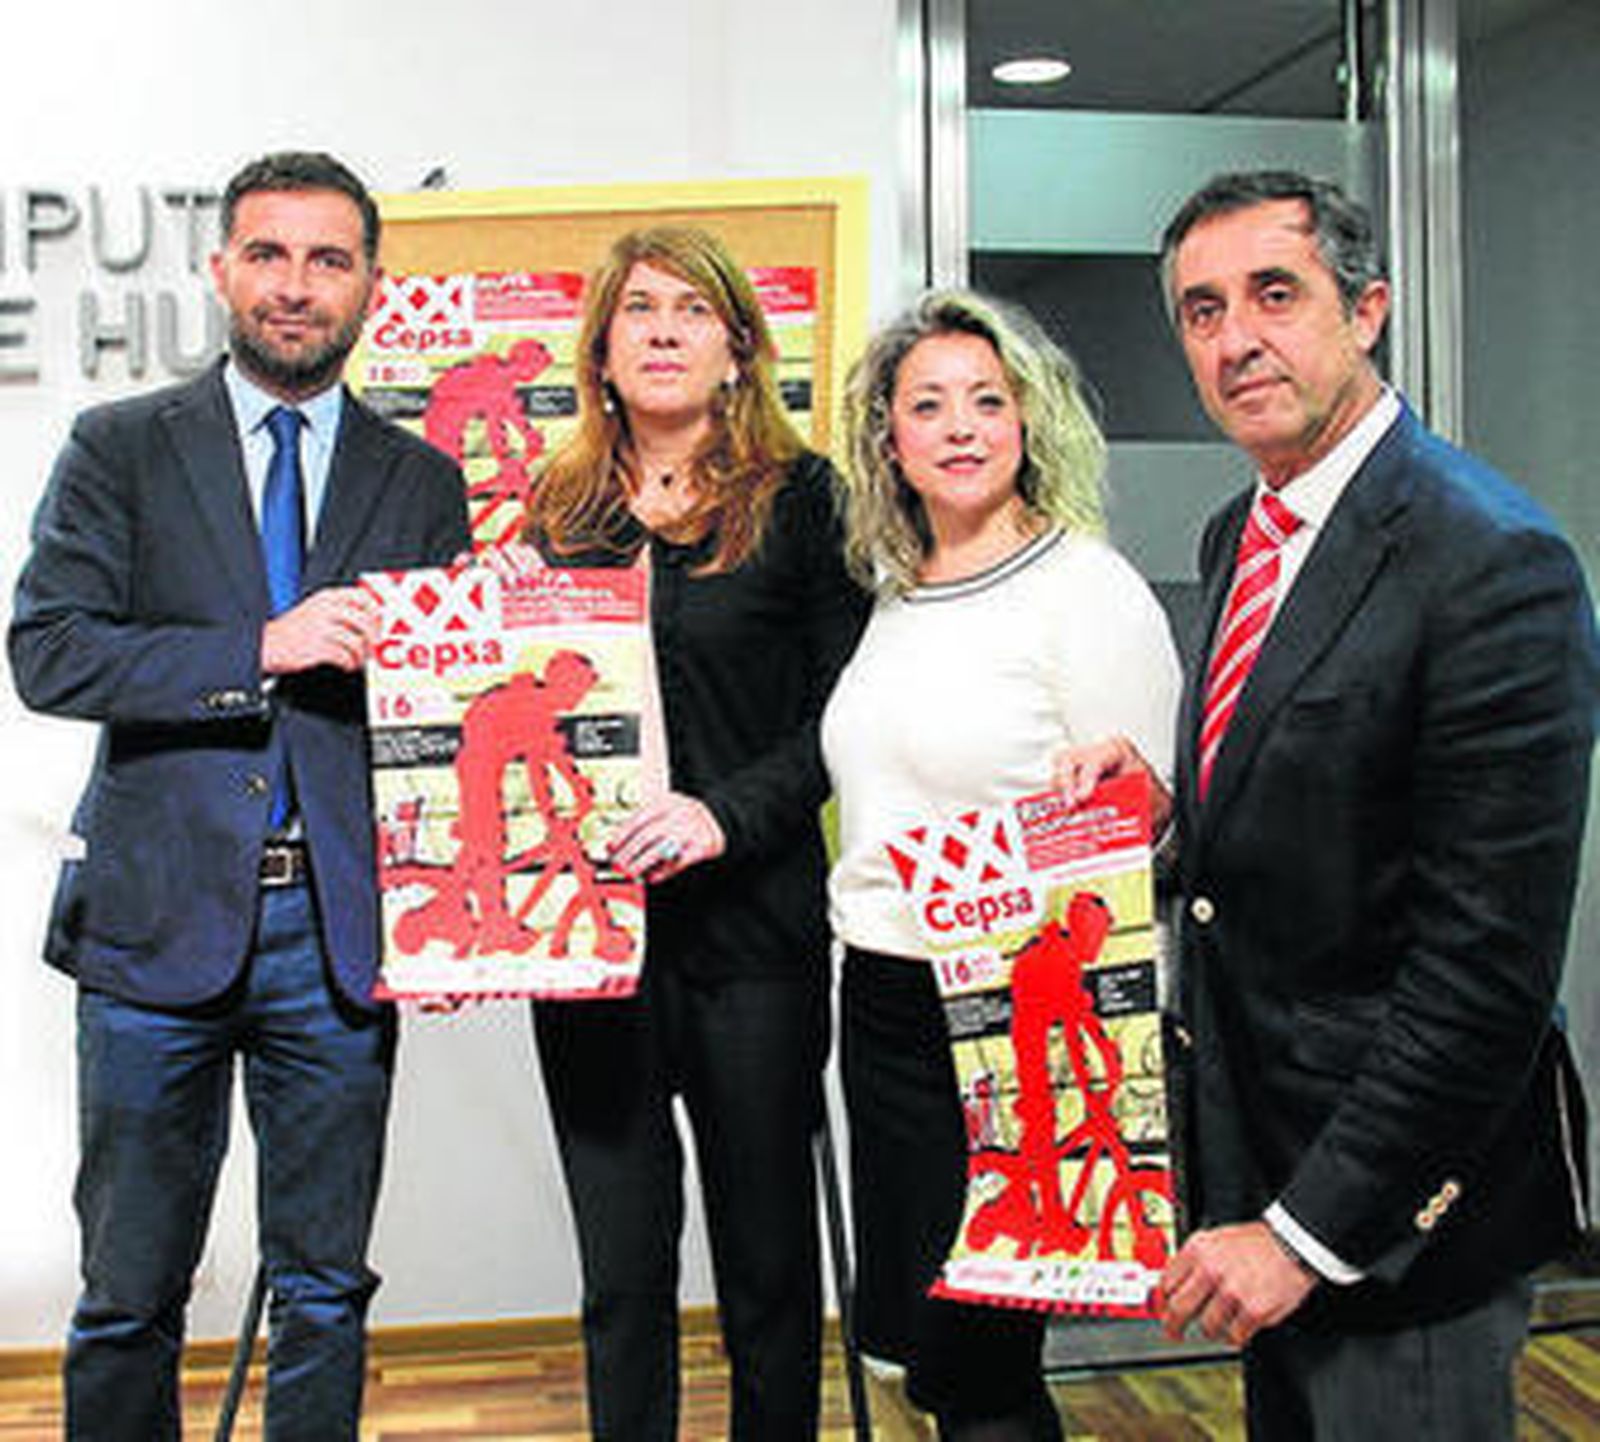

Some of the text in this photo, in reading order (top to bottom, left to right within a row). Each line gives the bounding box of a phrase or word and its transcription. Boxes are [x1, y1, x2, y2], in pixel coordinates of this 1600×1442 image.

[373, 323, 473, 350] Cepsa
[376, 638, 503, 677] Cepsa
[924, 885, 1034, 933] Cepsa
[940, 956, 971, 987] 16
